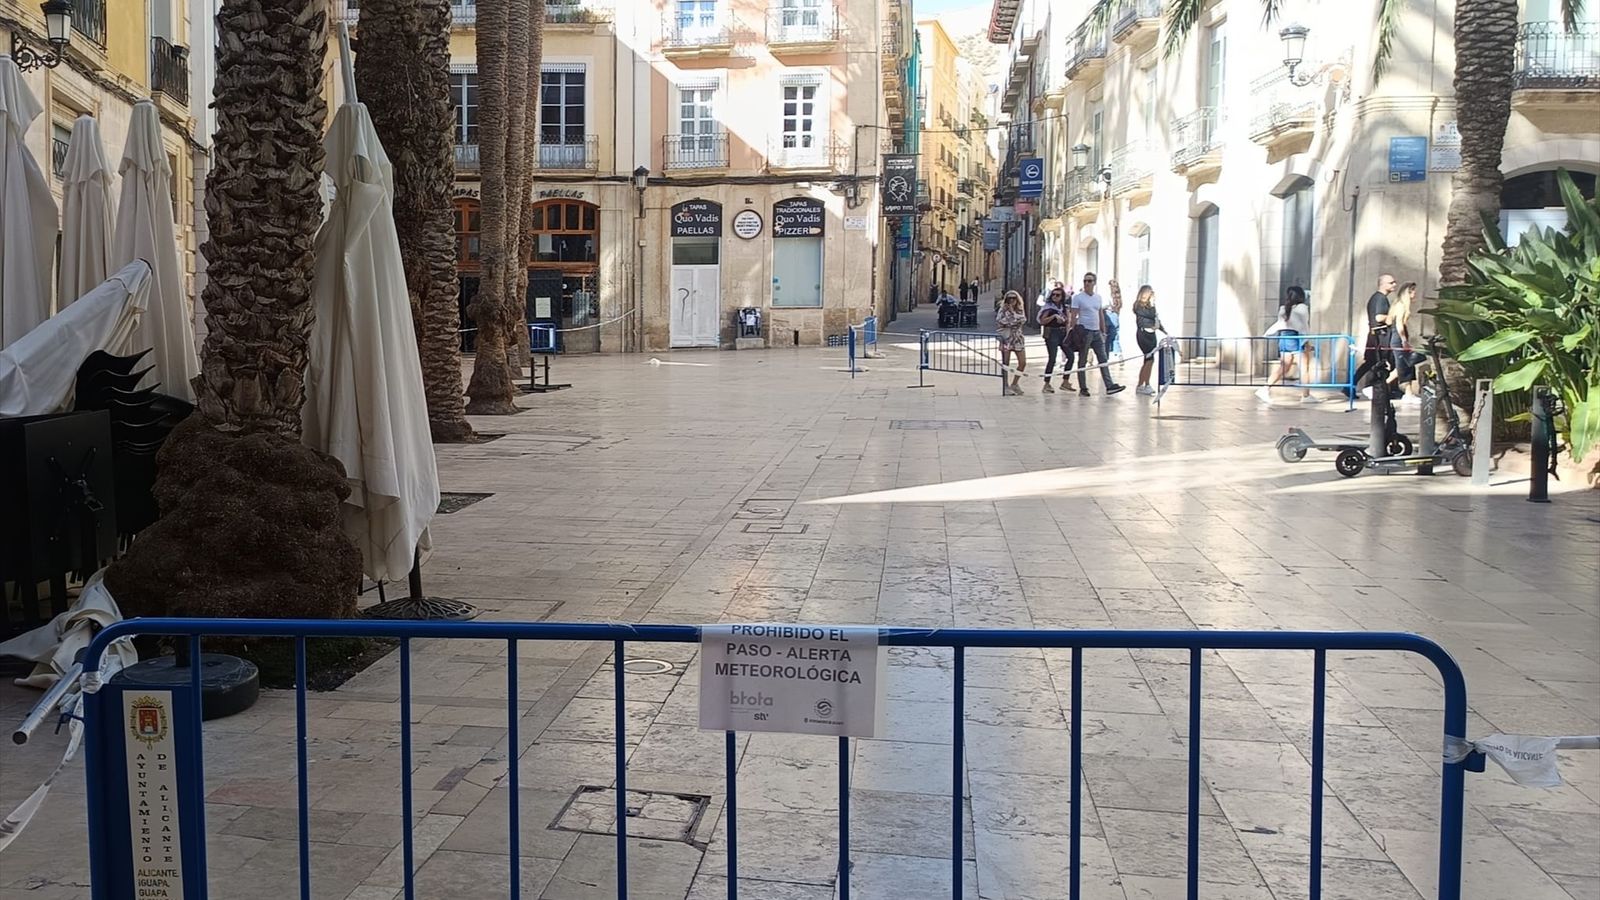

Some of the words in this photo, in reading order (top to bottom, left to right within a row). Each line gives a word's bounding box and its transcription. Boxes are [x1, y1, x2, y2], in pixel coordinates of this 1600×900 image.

[539, 189, 585, 199] PAELLAS
[674, 212, 694, 224] Quo
[695, 213, 719, 223] Vadis
[775, 214, 795, 223] Quo
[796, 214, 821, 223] Vadis
[677, 226, 715, 235] PAELLAS
[731, 624, 824, 640] PROHIBIDO
[829, 629, 849, 642] EL
[726, 643, 772, 657] PASO
[786, 646, 852, 662] ALERTA
[715, 662, 862, 684] METEOROLÓGICA
[156, 753, 167, 770] DE
[136, 753, 152, 863] AYUNTAMIENTO
[159, 784, 173, 863] ALICANTE
